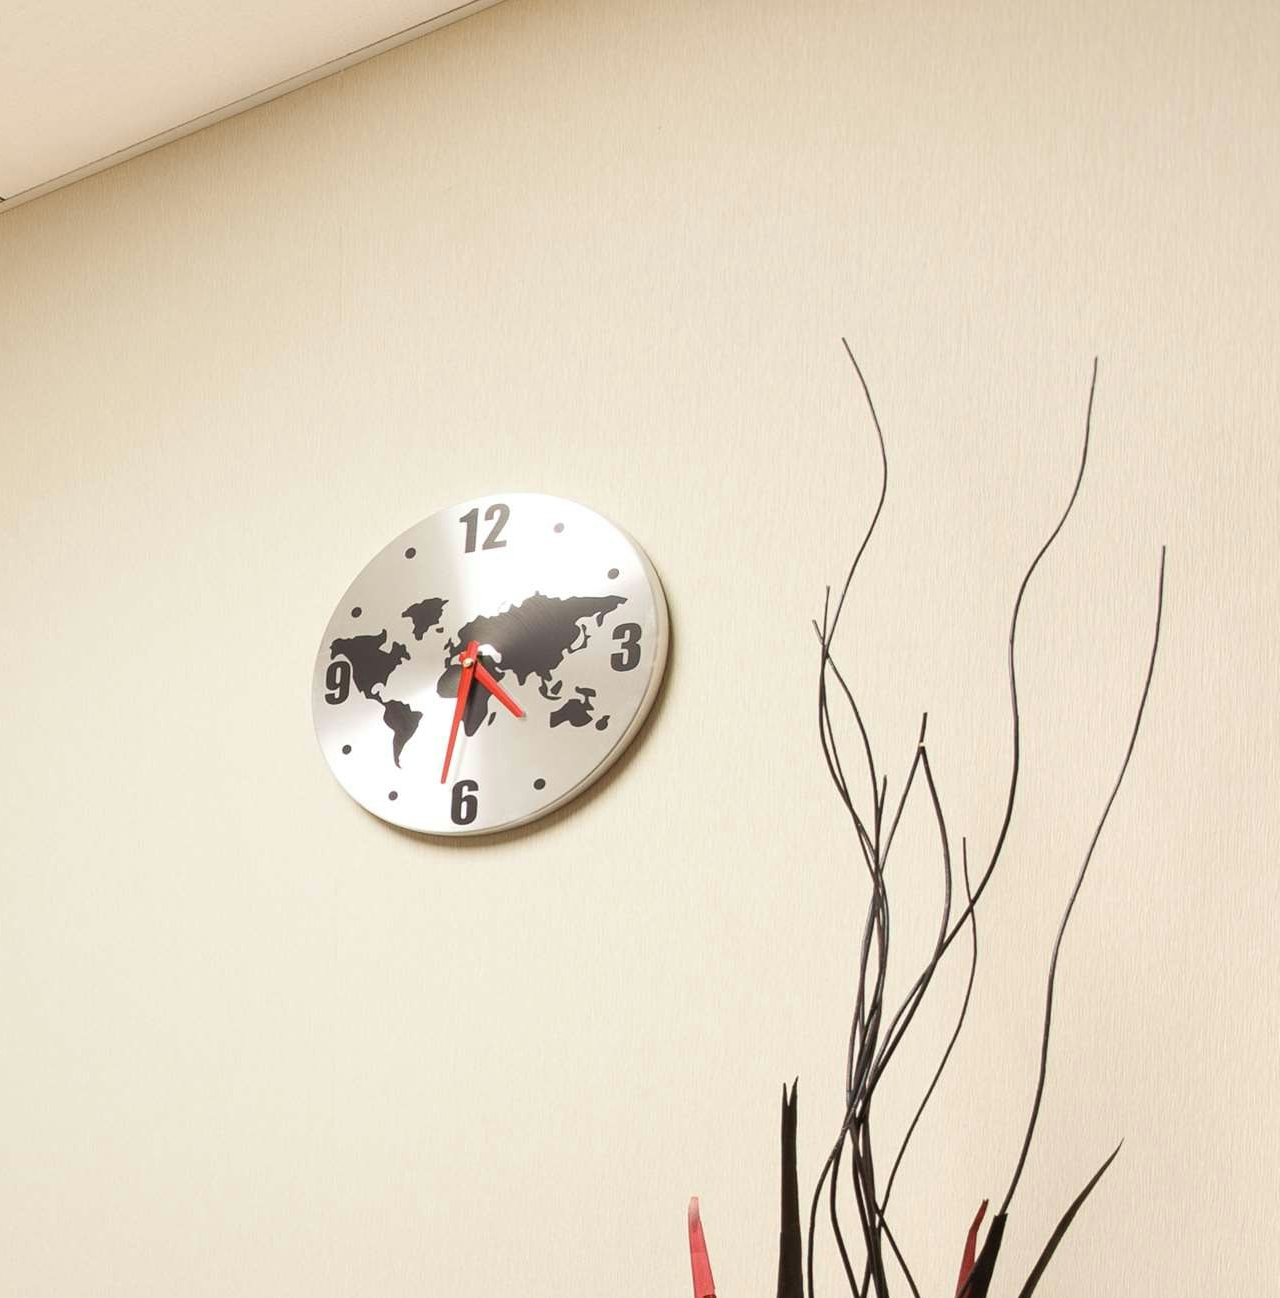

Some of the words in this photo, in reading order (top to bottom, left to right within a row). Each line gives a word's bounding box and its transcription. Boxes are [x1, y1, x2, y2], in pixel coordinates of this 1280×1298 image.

[459, 503, 510, 554] 12
[610, 622, 643, 673] 3
[325, 660, 352, 706] 9
[450, 779, 479, 826] 6
